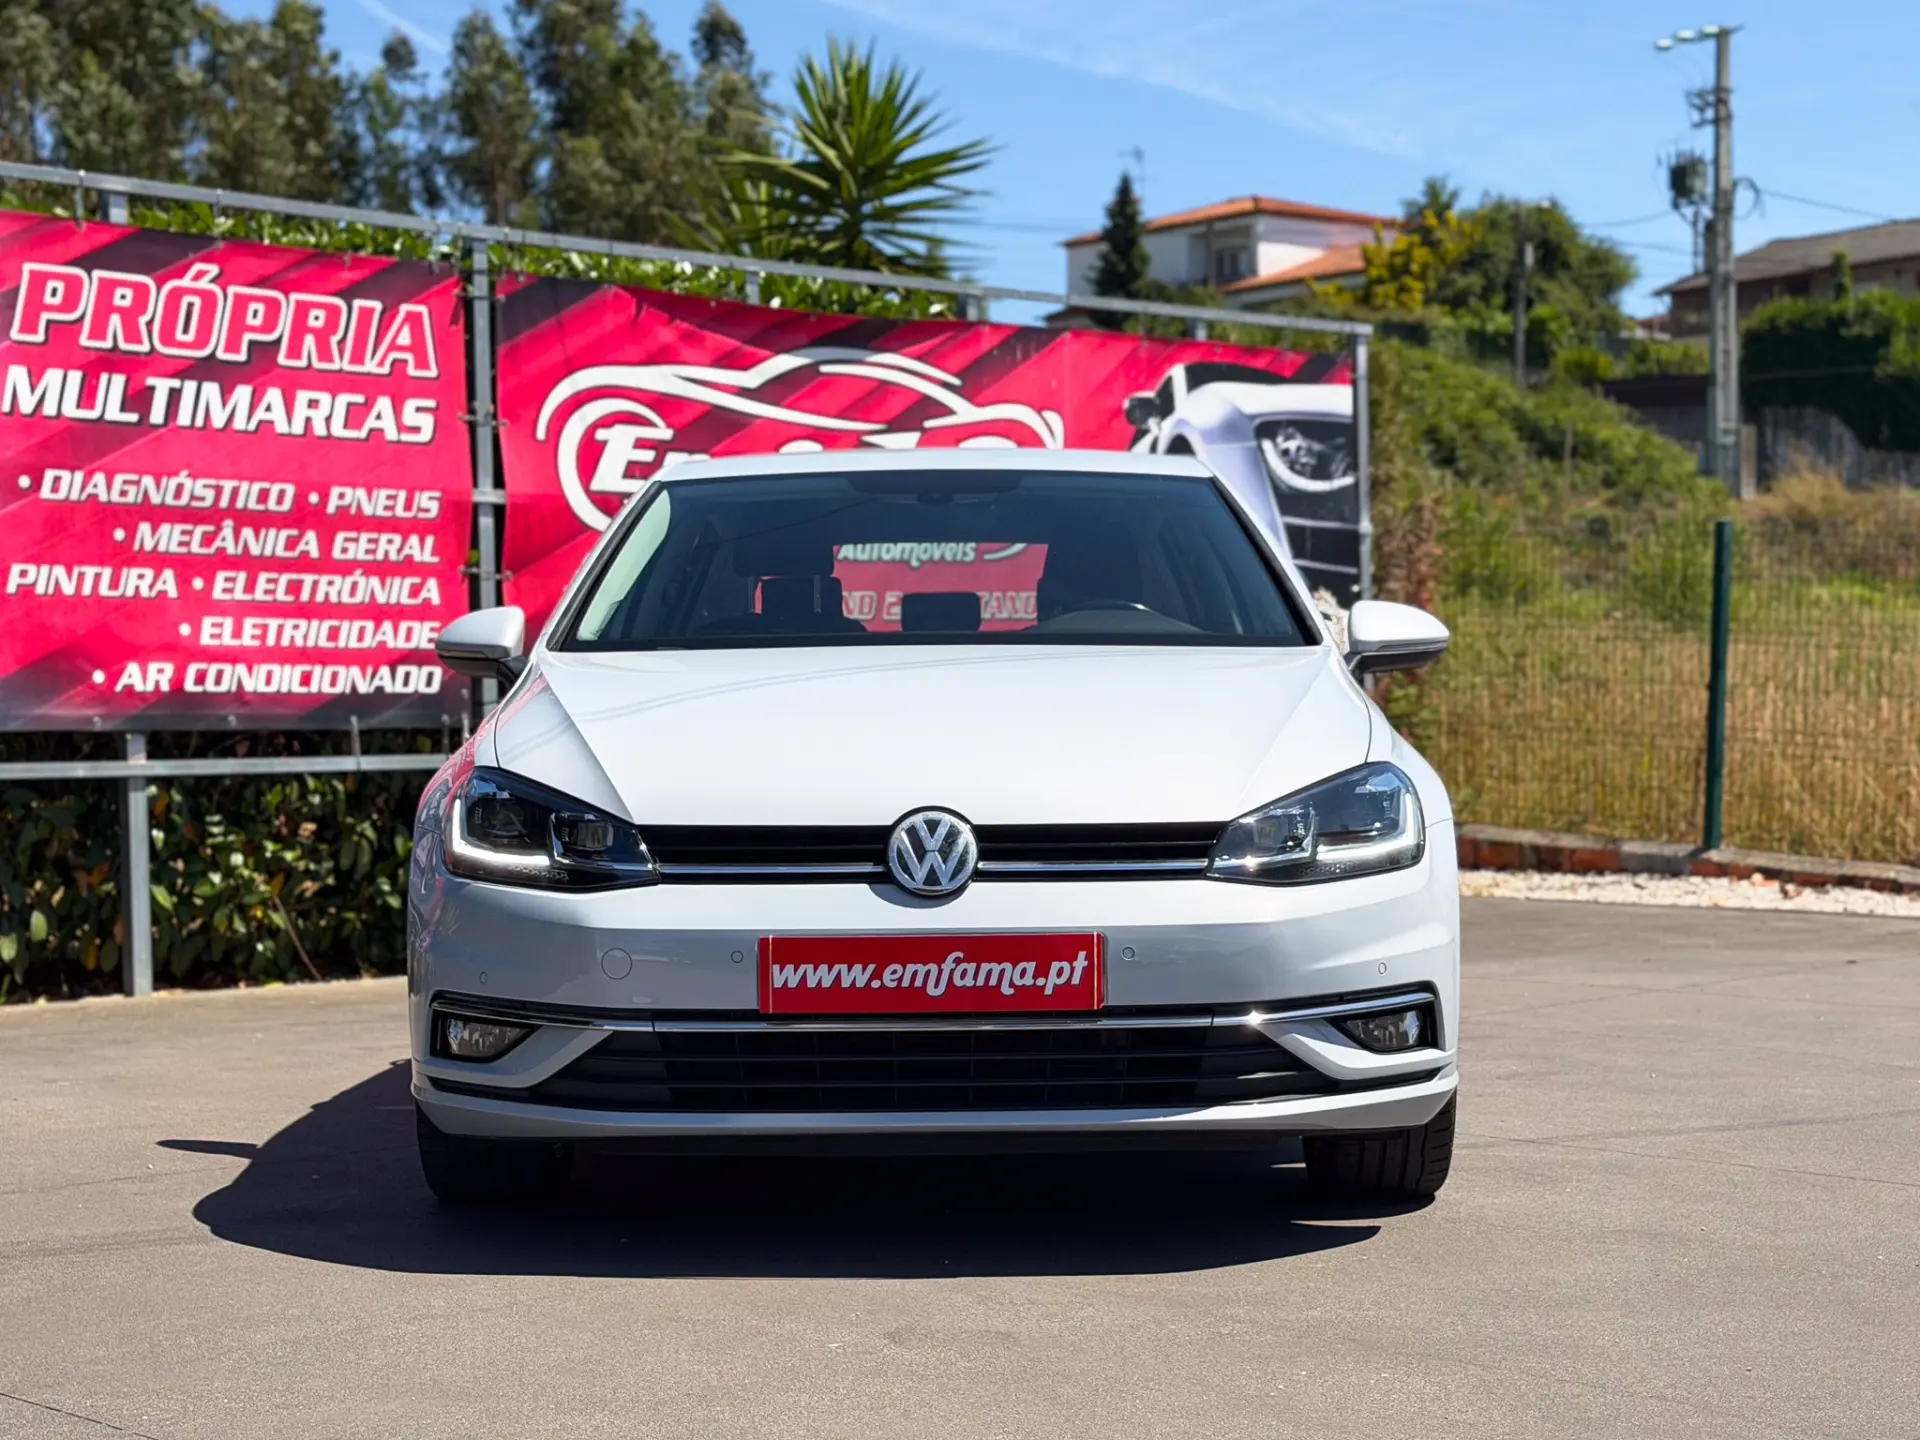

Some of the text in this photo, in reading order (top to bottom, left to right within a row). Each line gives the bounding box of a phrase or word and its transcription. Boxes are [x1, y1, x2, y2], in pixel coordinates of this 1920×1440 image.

[10, 262, 439, 379] PRÓPRIA
[1, 363, 438, 444] MULTIMARCAS
[39, 469, 441, 519] DIAGNÓSTICO PNEUS
[133, 519, 440, 564] MECÂNICA GERAL
[6, 563, 441, 606] PINTURA ELECTRÓNICA
[199, 616, 441, 651] ELETRICIDADE
[115, 661, 443, 695] AR CONDICIONADO
[772, 950, 1089, 997] www.emfama.pt
